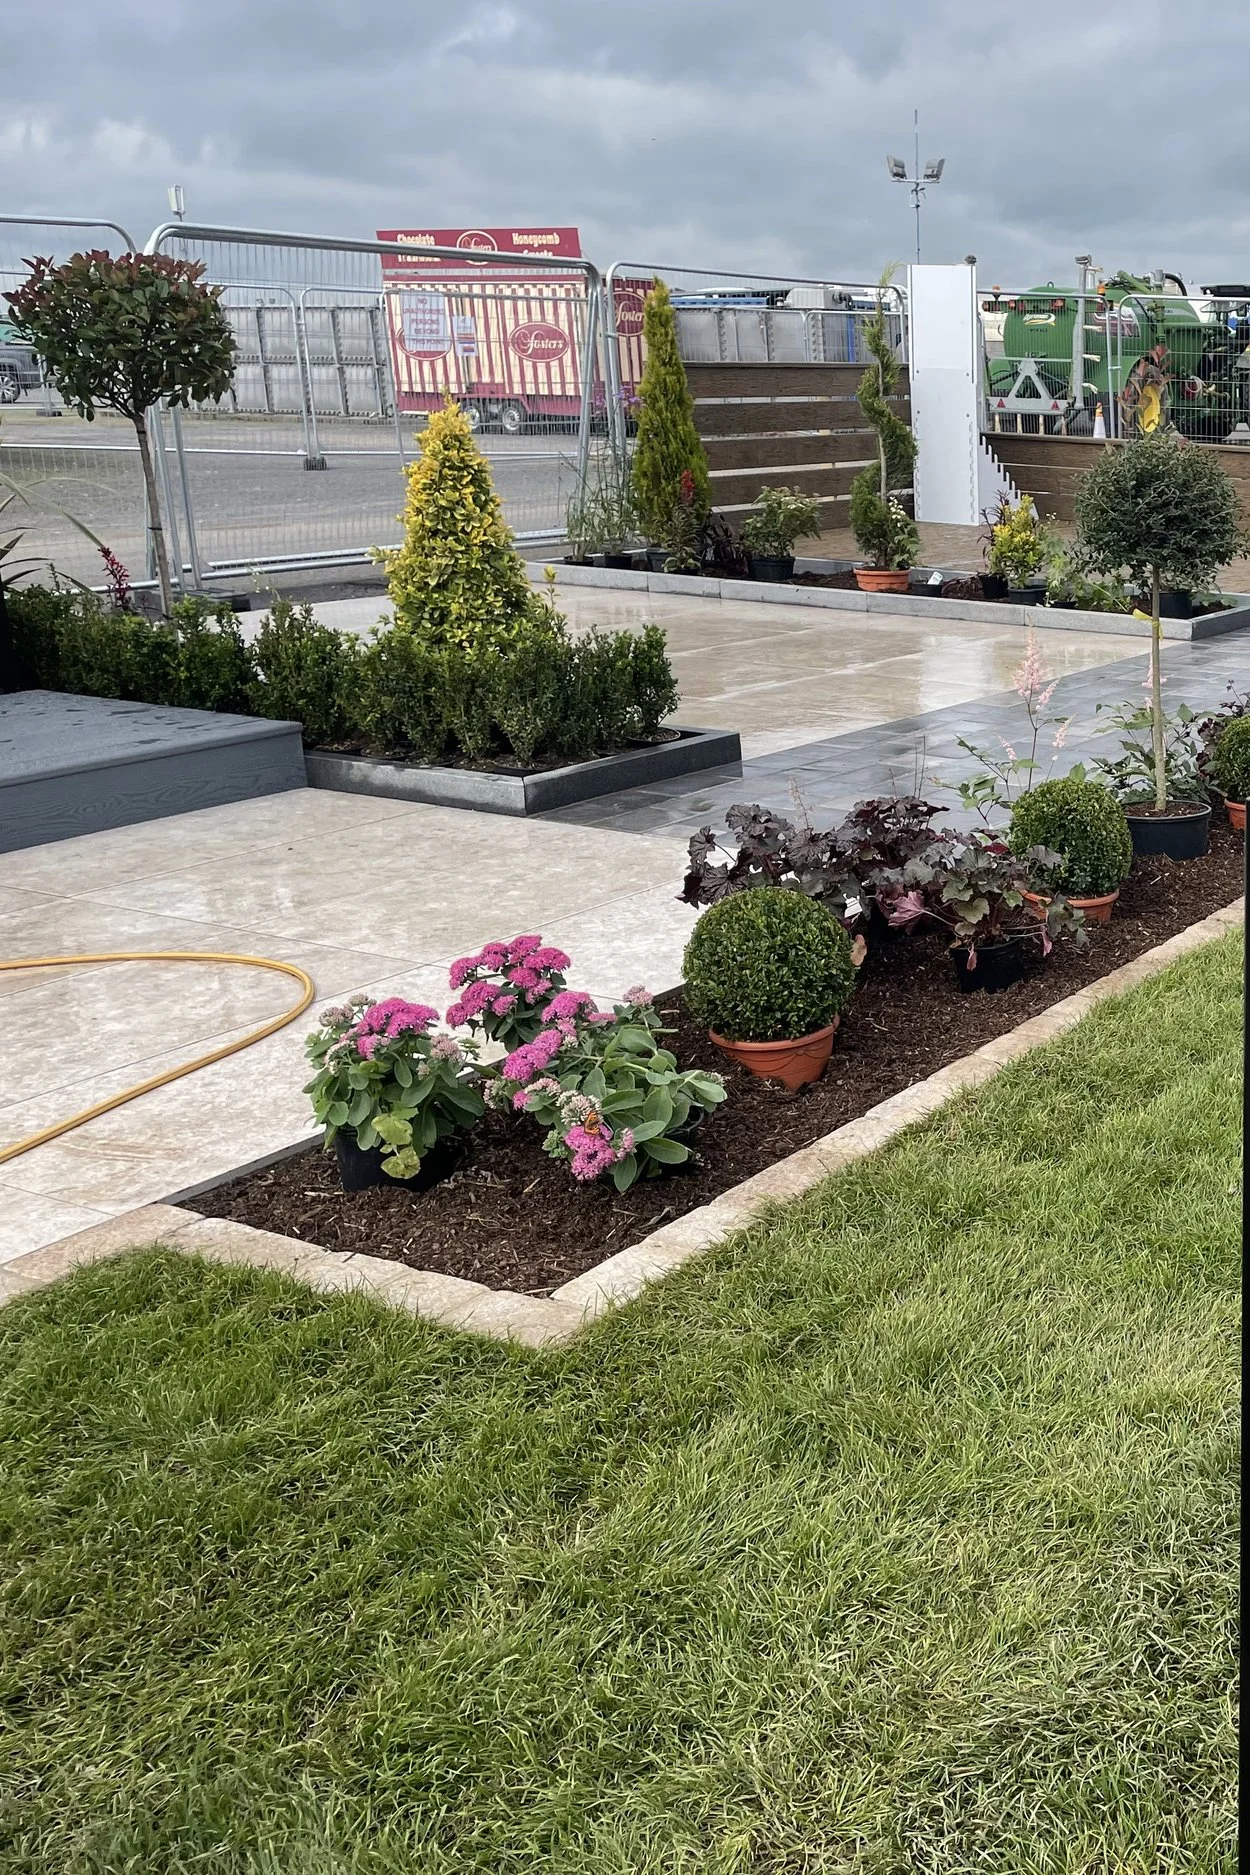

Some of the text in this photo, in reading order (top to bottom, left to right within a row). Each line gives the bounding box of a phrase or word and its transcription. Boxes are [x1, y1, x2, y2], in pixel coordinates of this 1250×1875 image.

[397, 233, 435, 246] Chocolate
[512, 232, 560, 248] Honeycomb
[514, 329, 563, 356] Fosters
